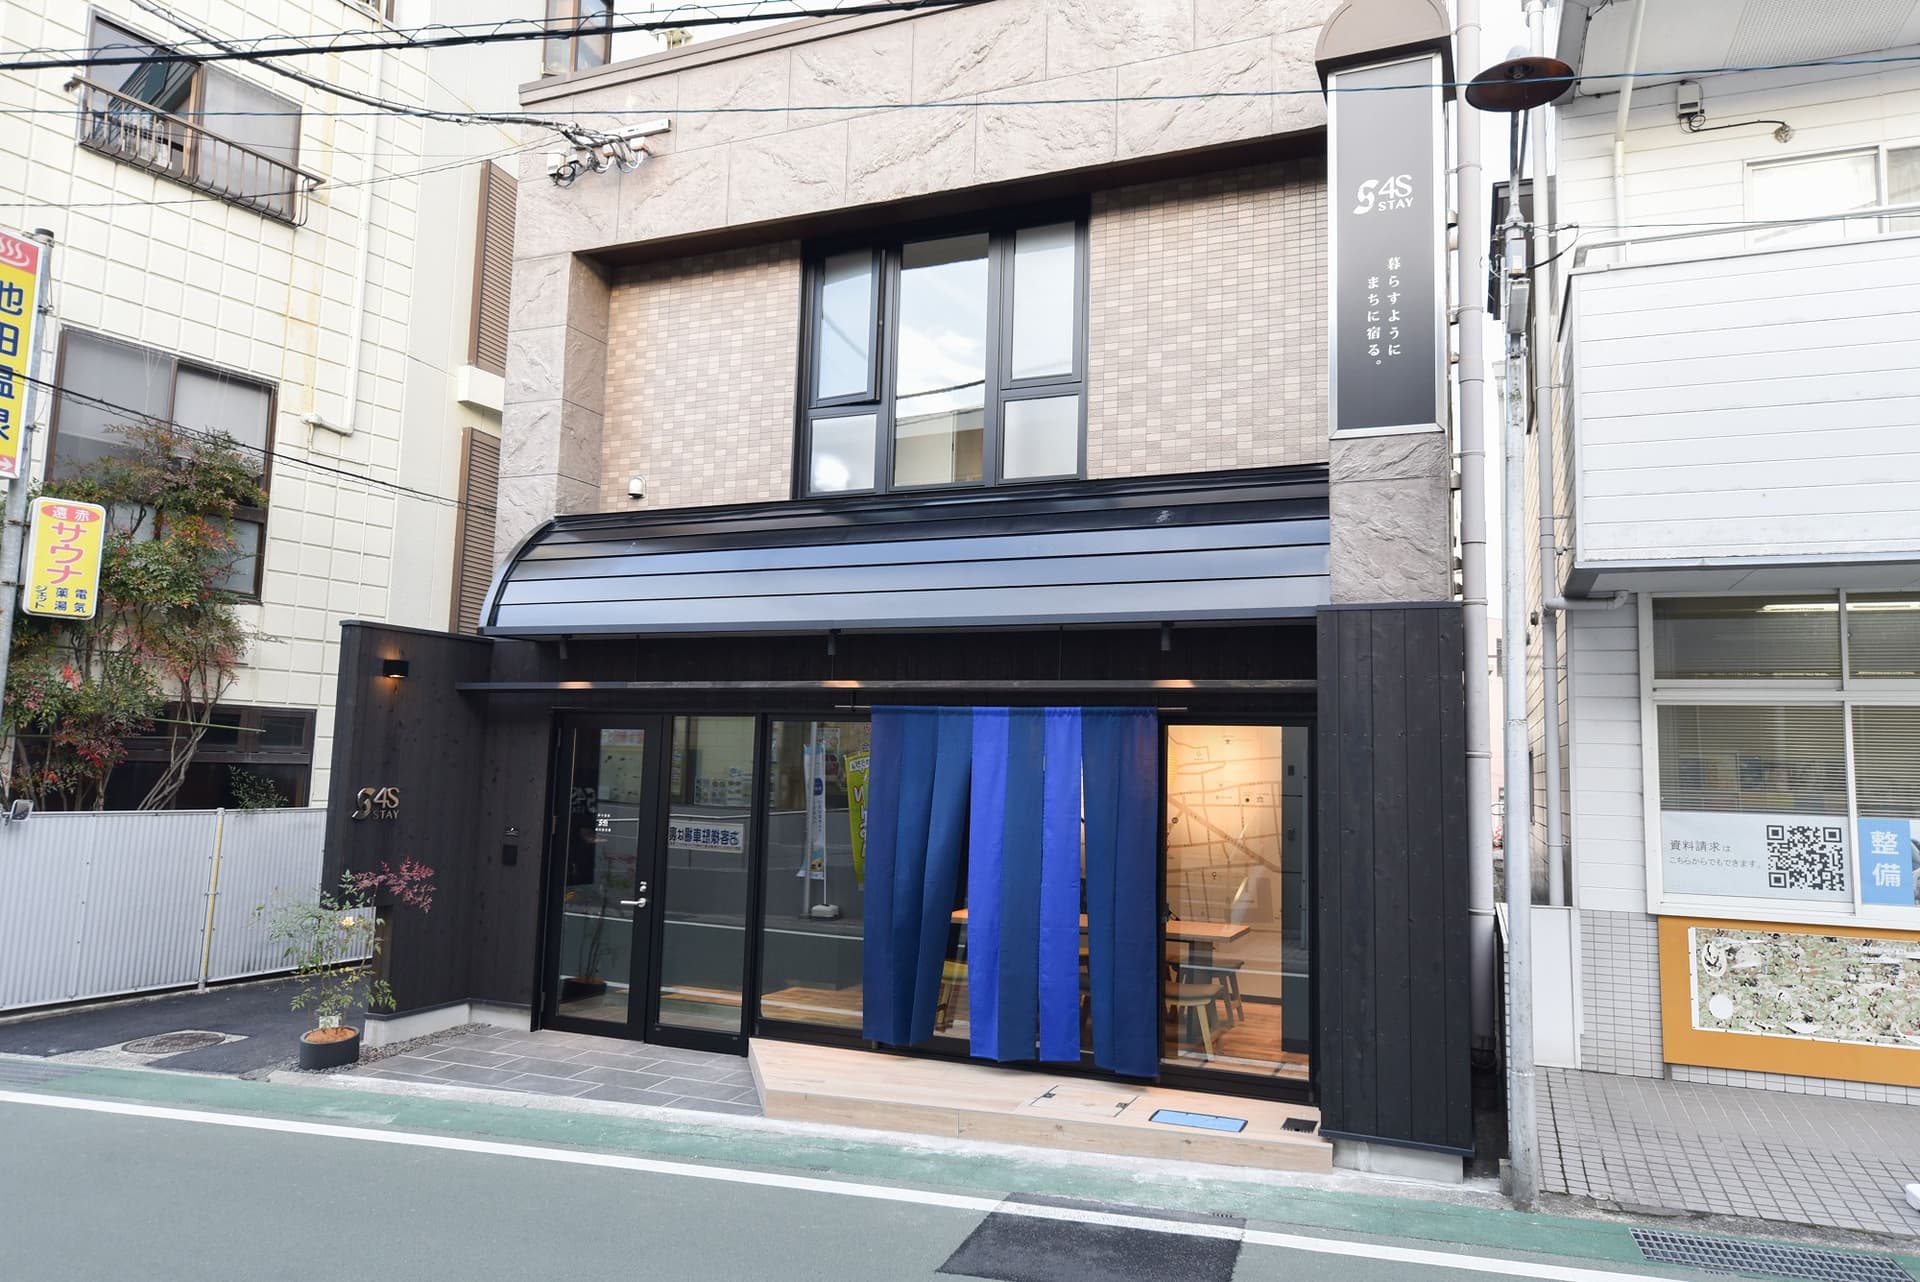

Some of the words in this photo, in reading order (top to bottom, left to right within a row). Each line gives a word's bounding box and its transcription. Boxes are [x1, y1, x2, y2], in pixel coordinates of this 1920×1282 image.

[1378, 197, 1414, 212] STAY
[1366, 276, 1382, 365] まちに宿る。
[1387, 256, 1401, 357] 暮らすように
[47, 522, 87, 585] サウナ
[74, 588, 88, 614] 電気
[372, 809, 400, 821] STAY
[1669, 839, 1732, 852] 資料請求は
[1870, 830, 1902, 888] 整備
